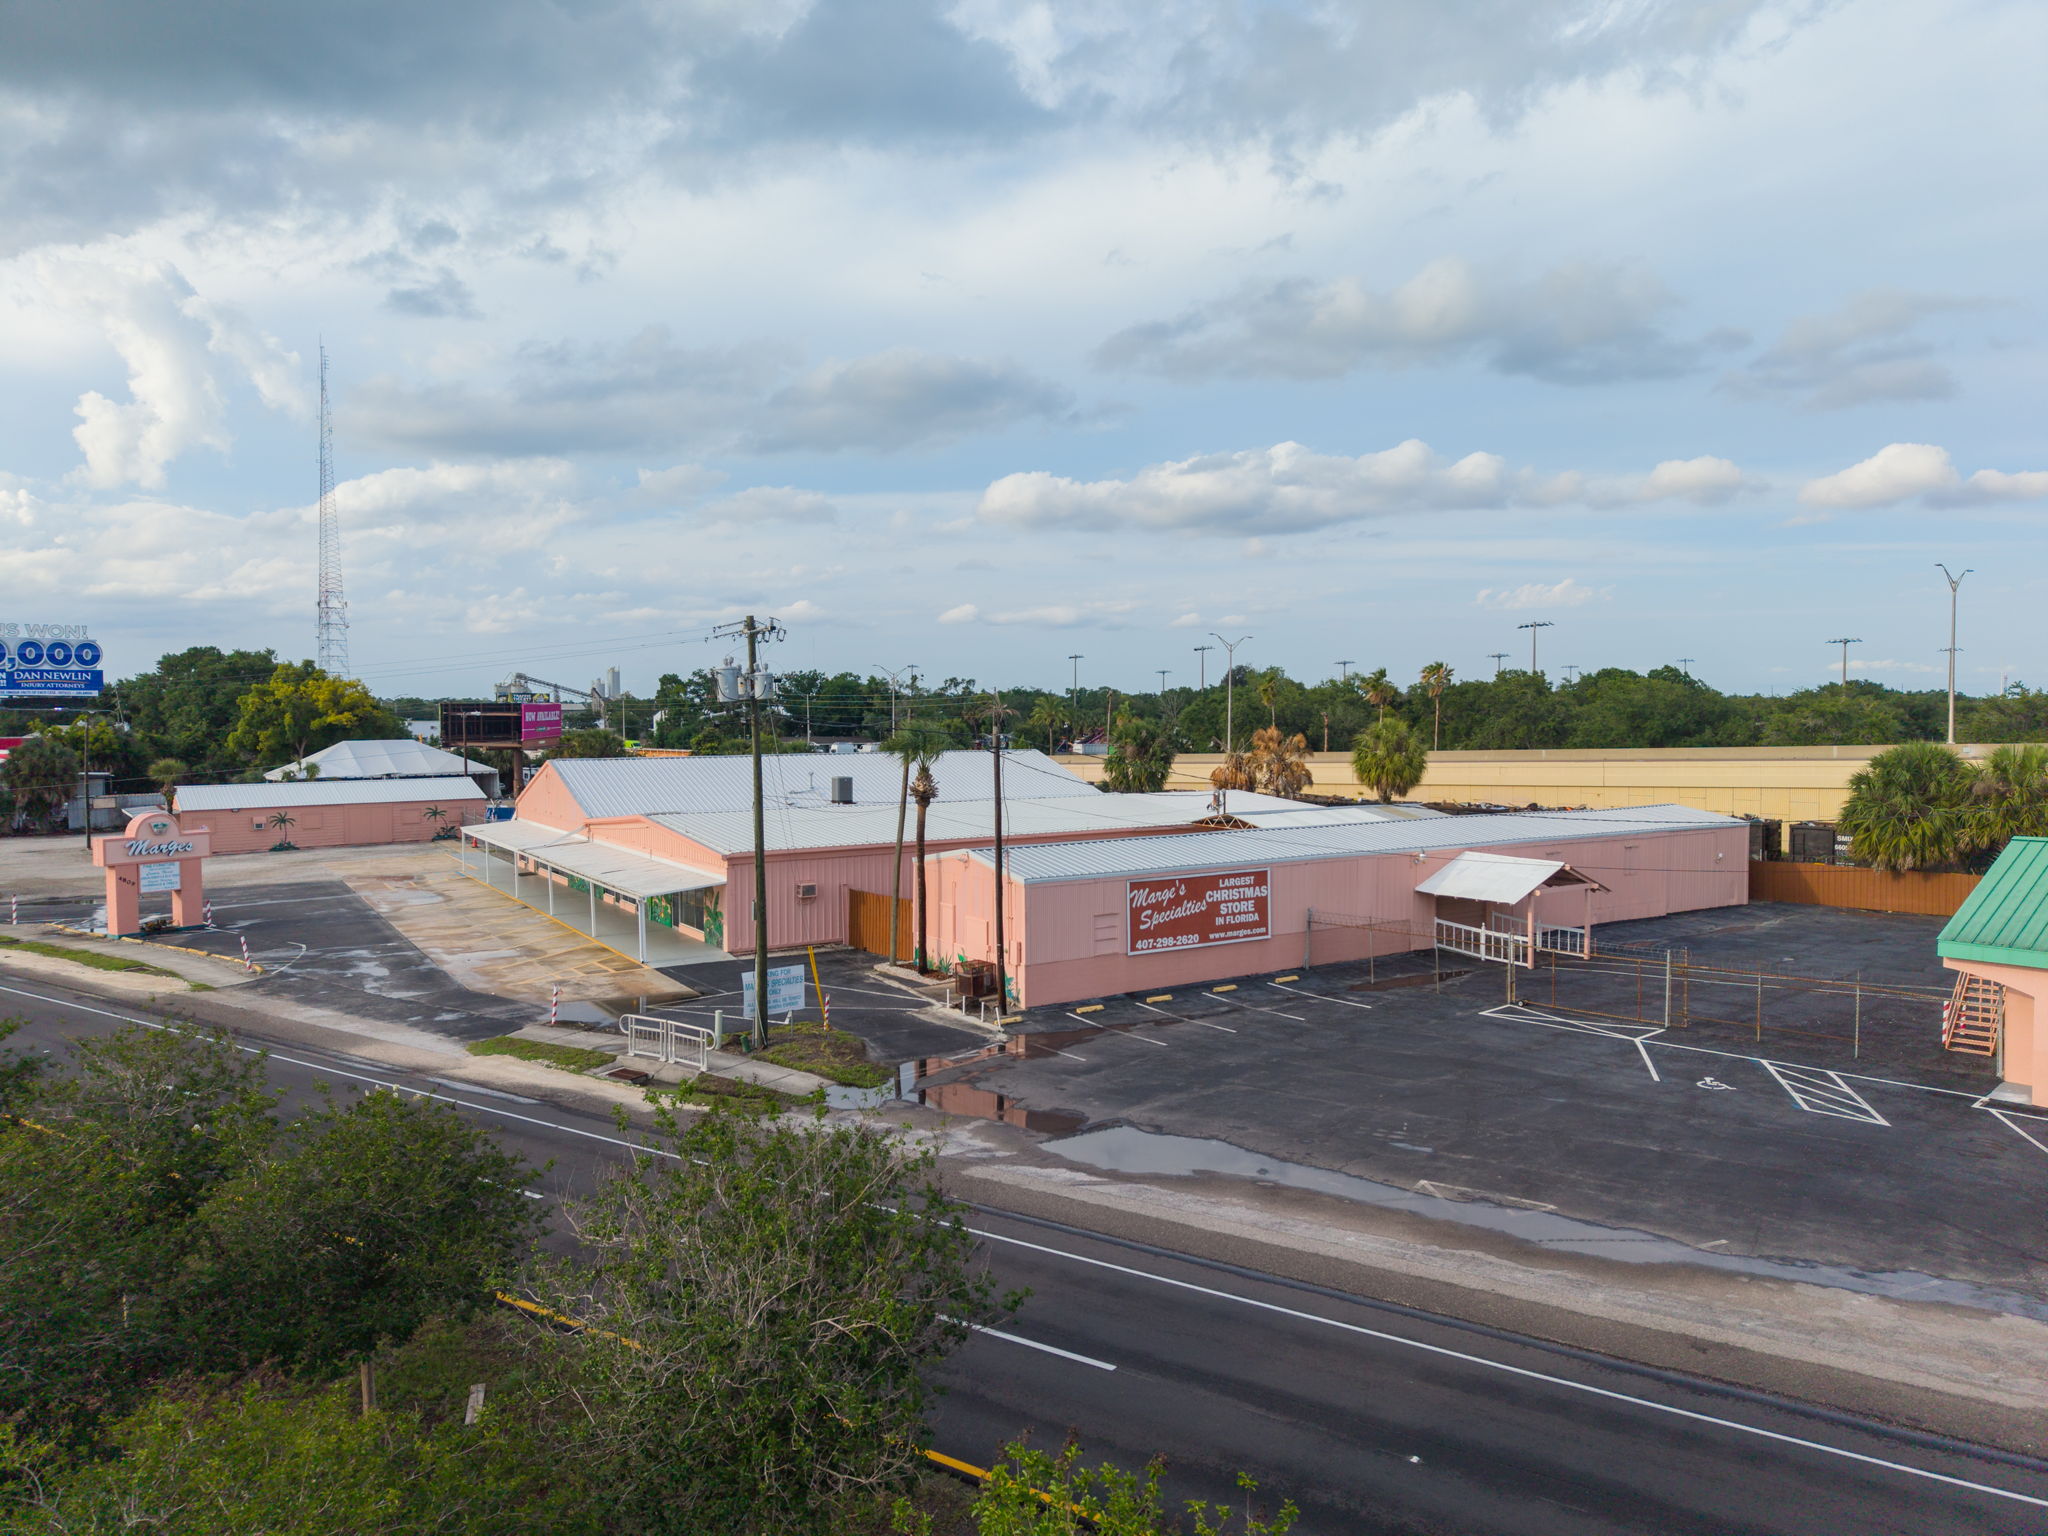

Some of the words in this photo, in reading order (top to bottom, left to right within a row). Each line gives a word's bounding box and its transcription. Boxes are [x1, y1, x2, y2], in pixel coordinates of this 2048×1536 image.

[24, 623, 88, 639] WON!
[0, 640, 103, 672] ,000
[14, 671, 41, 680] DAN
[43, 672, 91, 680] NEWLIN
[125, 840, 193, 857] Marges
[1219, 876, 1255, 888] LARGEST
[1130, 880, 1186, 908] Marge's
[1205, 885, 1268, 902] CHRISTMAS
[1139, 898, 1207, 930] Specialties
[1220, 900, 1255, 915] STORE
[1215, 916, 1225, 926] IN
[1226, 912, 1260, 925] FLORIDA
[1135, 934, 1199, 950] 407-298-2620
[780, 968, 791, 976] FOR
[771, 975, 804, 987] SPECIALTIES
